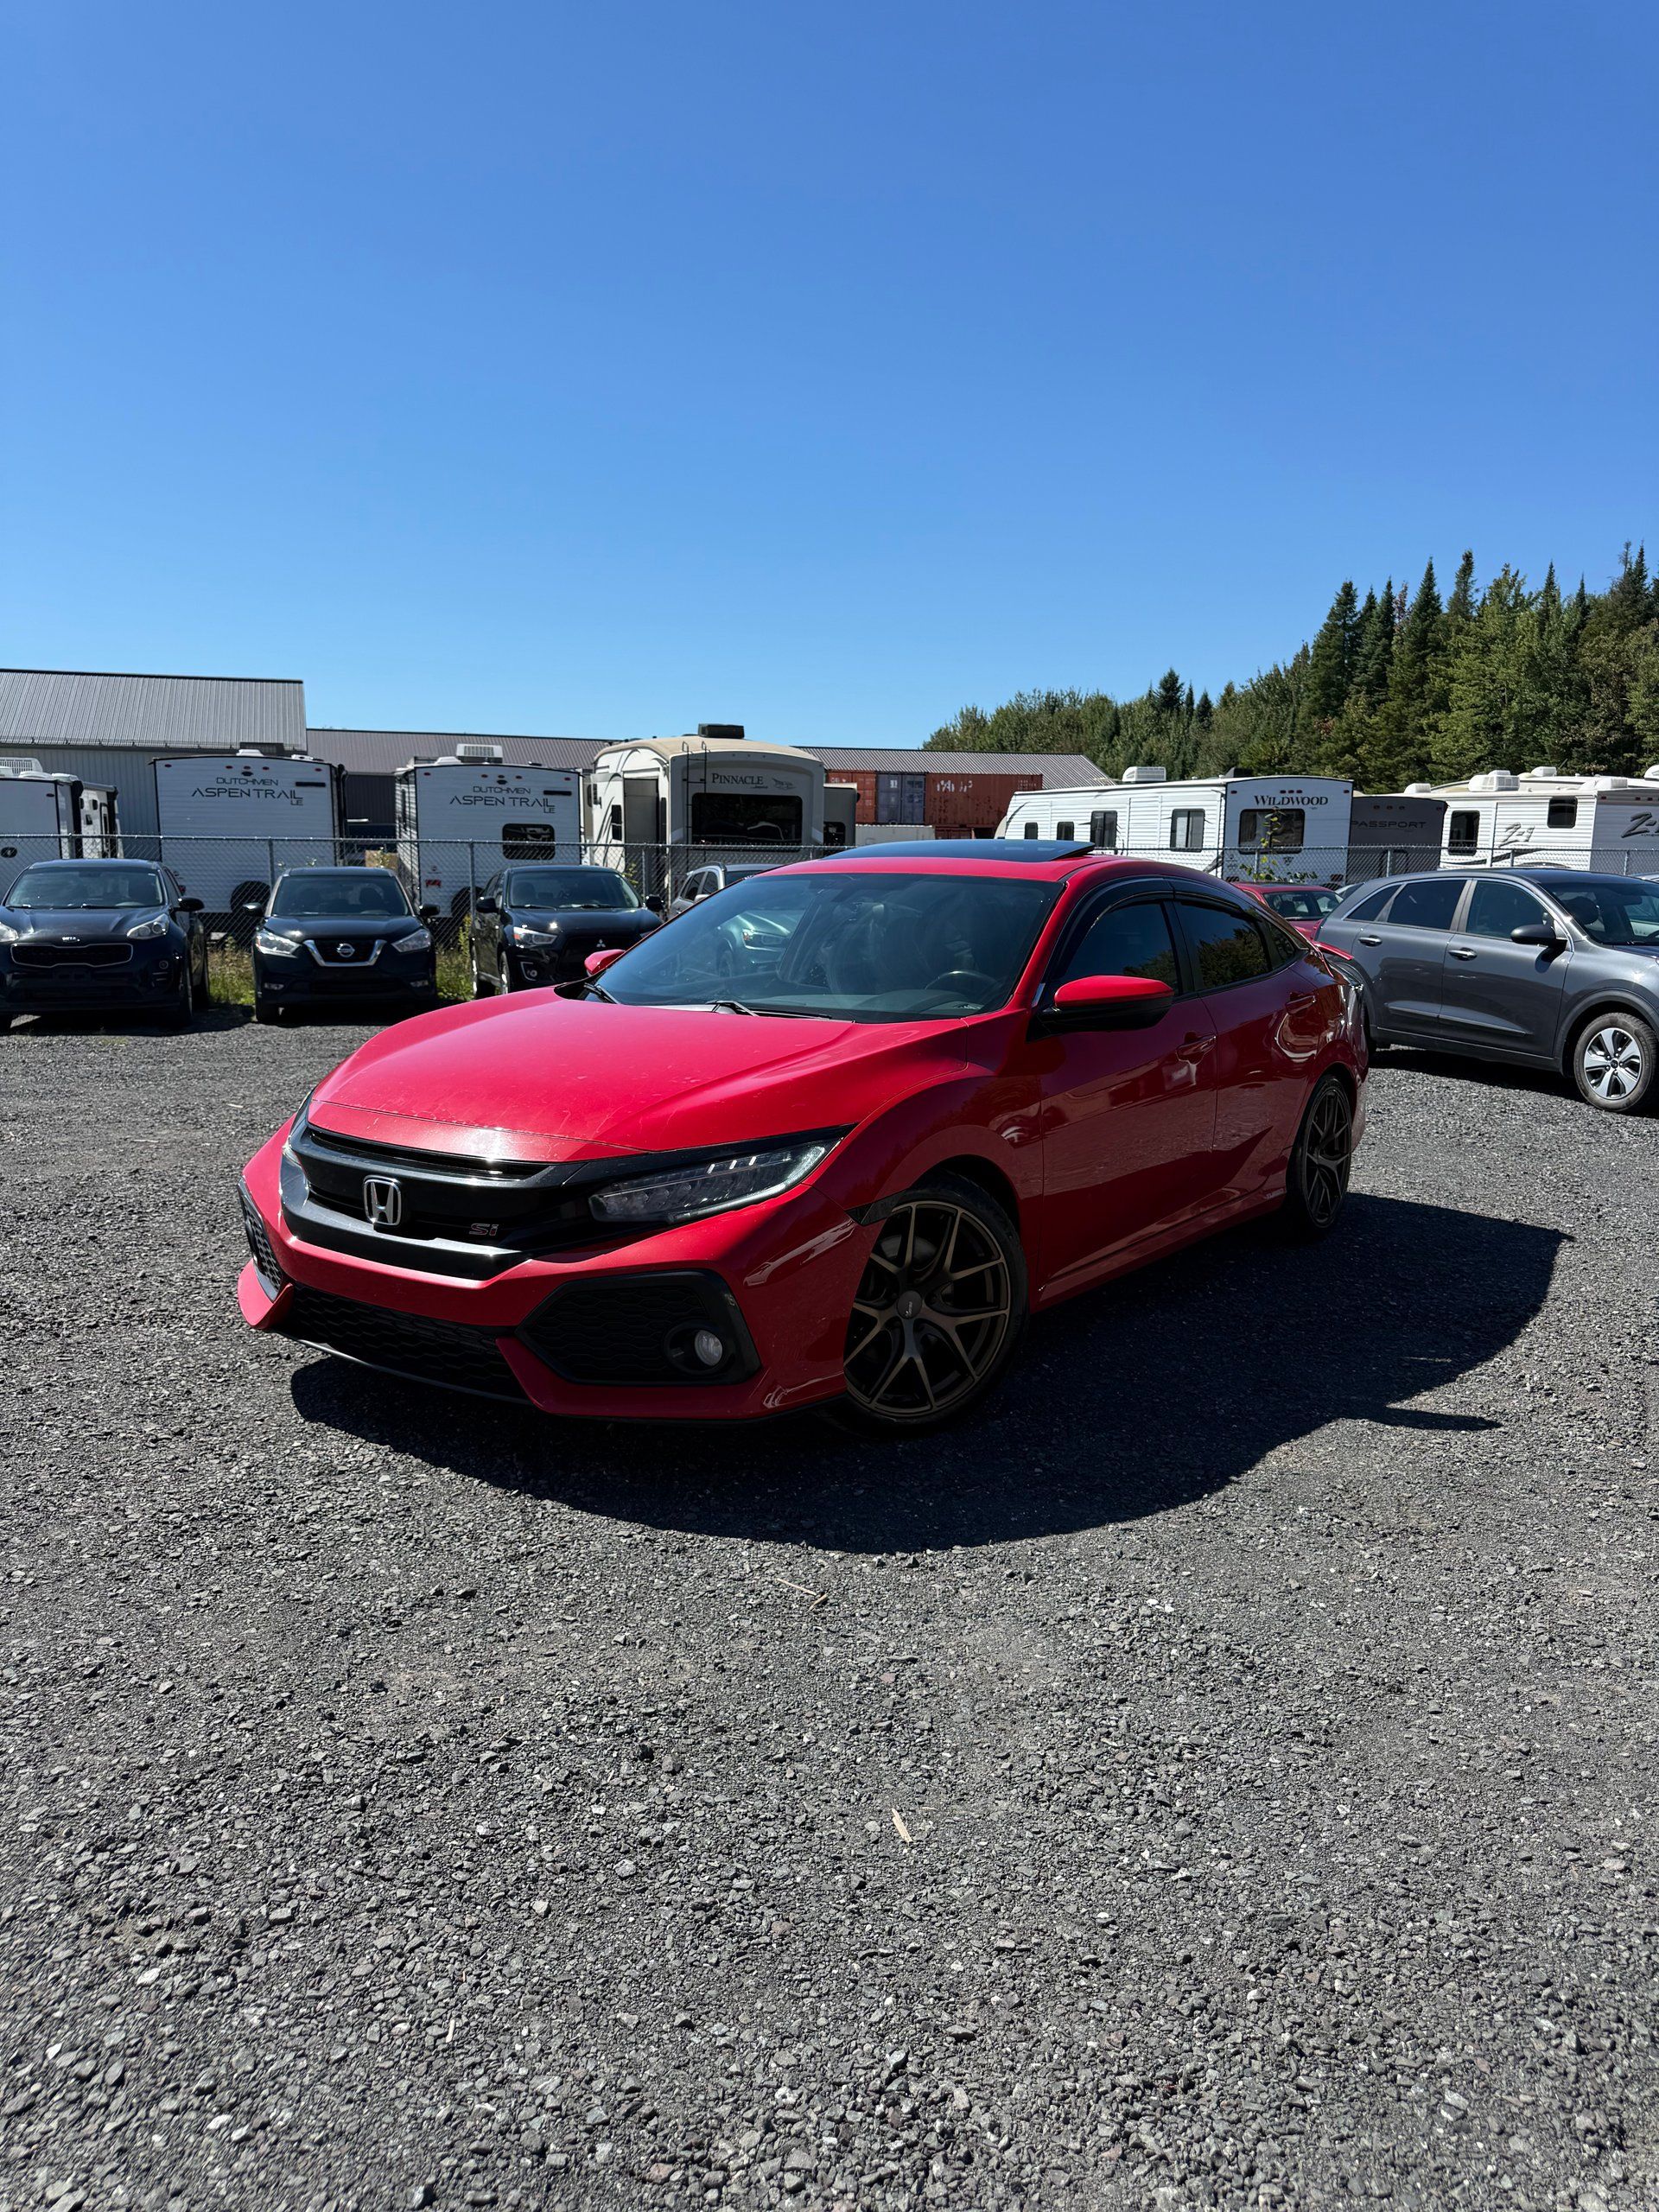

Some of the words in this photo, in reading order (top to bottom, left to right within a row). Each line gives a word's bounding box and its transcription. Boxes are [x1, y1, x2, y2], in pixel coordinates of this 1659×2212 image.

[216, 777, 279, 786] DUTCHMEN
[711, 772, 764, 785] PINNACLE
[191, 787, 251, 798] ASPEN
[252, 788, 303, 800] TRAIL
[473, 785, 531, 795] DUTCHMEN
[449, 795, 505, 806] ASPEN
[508, 797, 556, 808] TRAIL
[1254, 795, 1329, 806] WILDWOOD
[1351, 820, 1426, 830] PASSPORT
